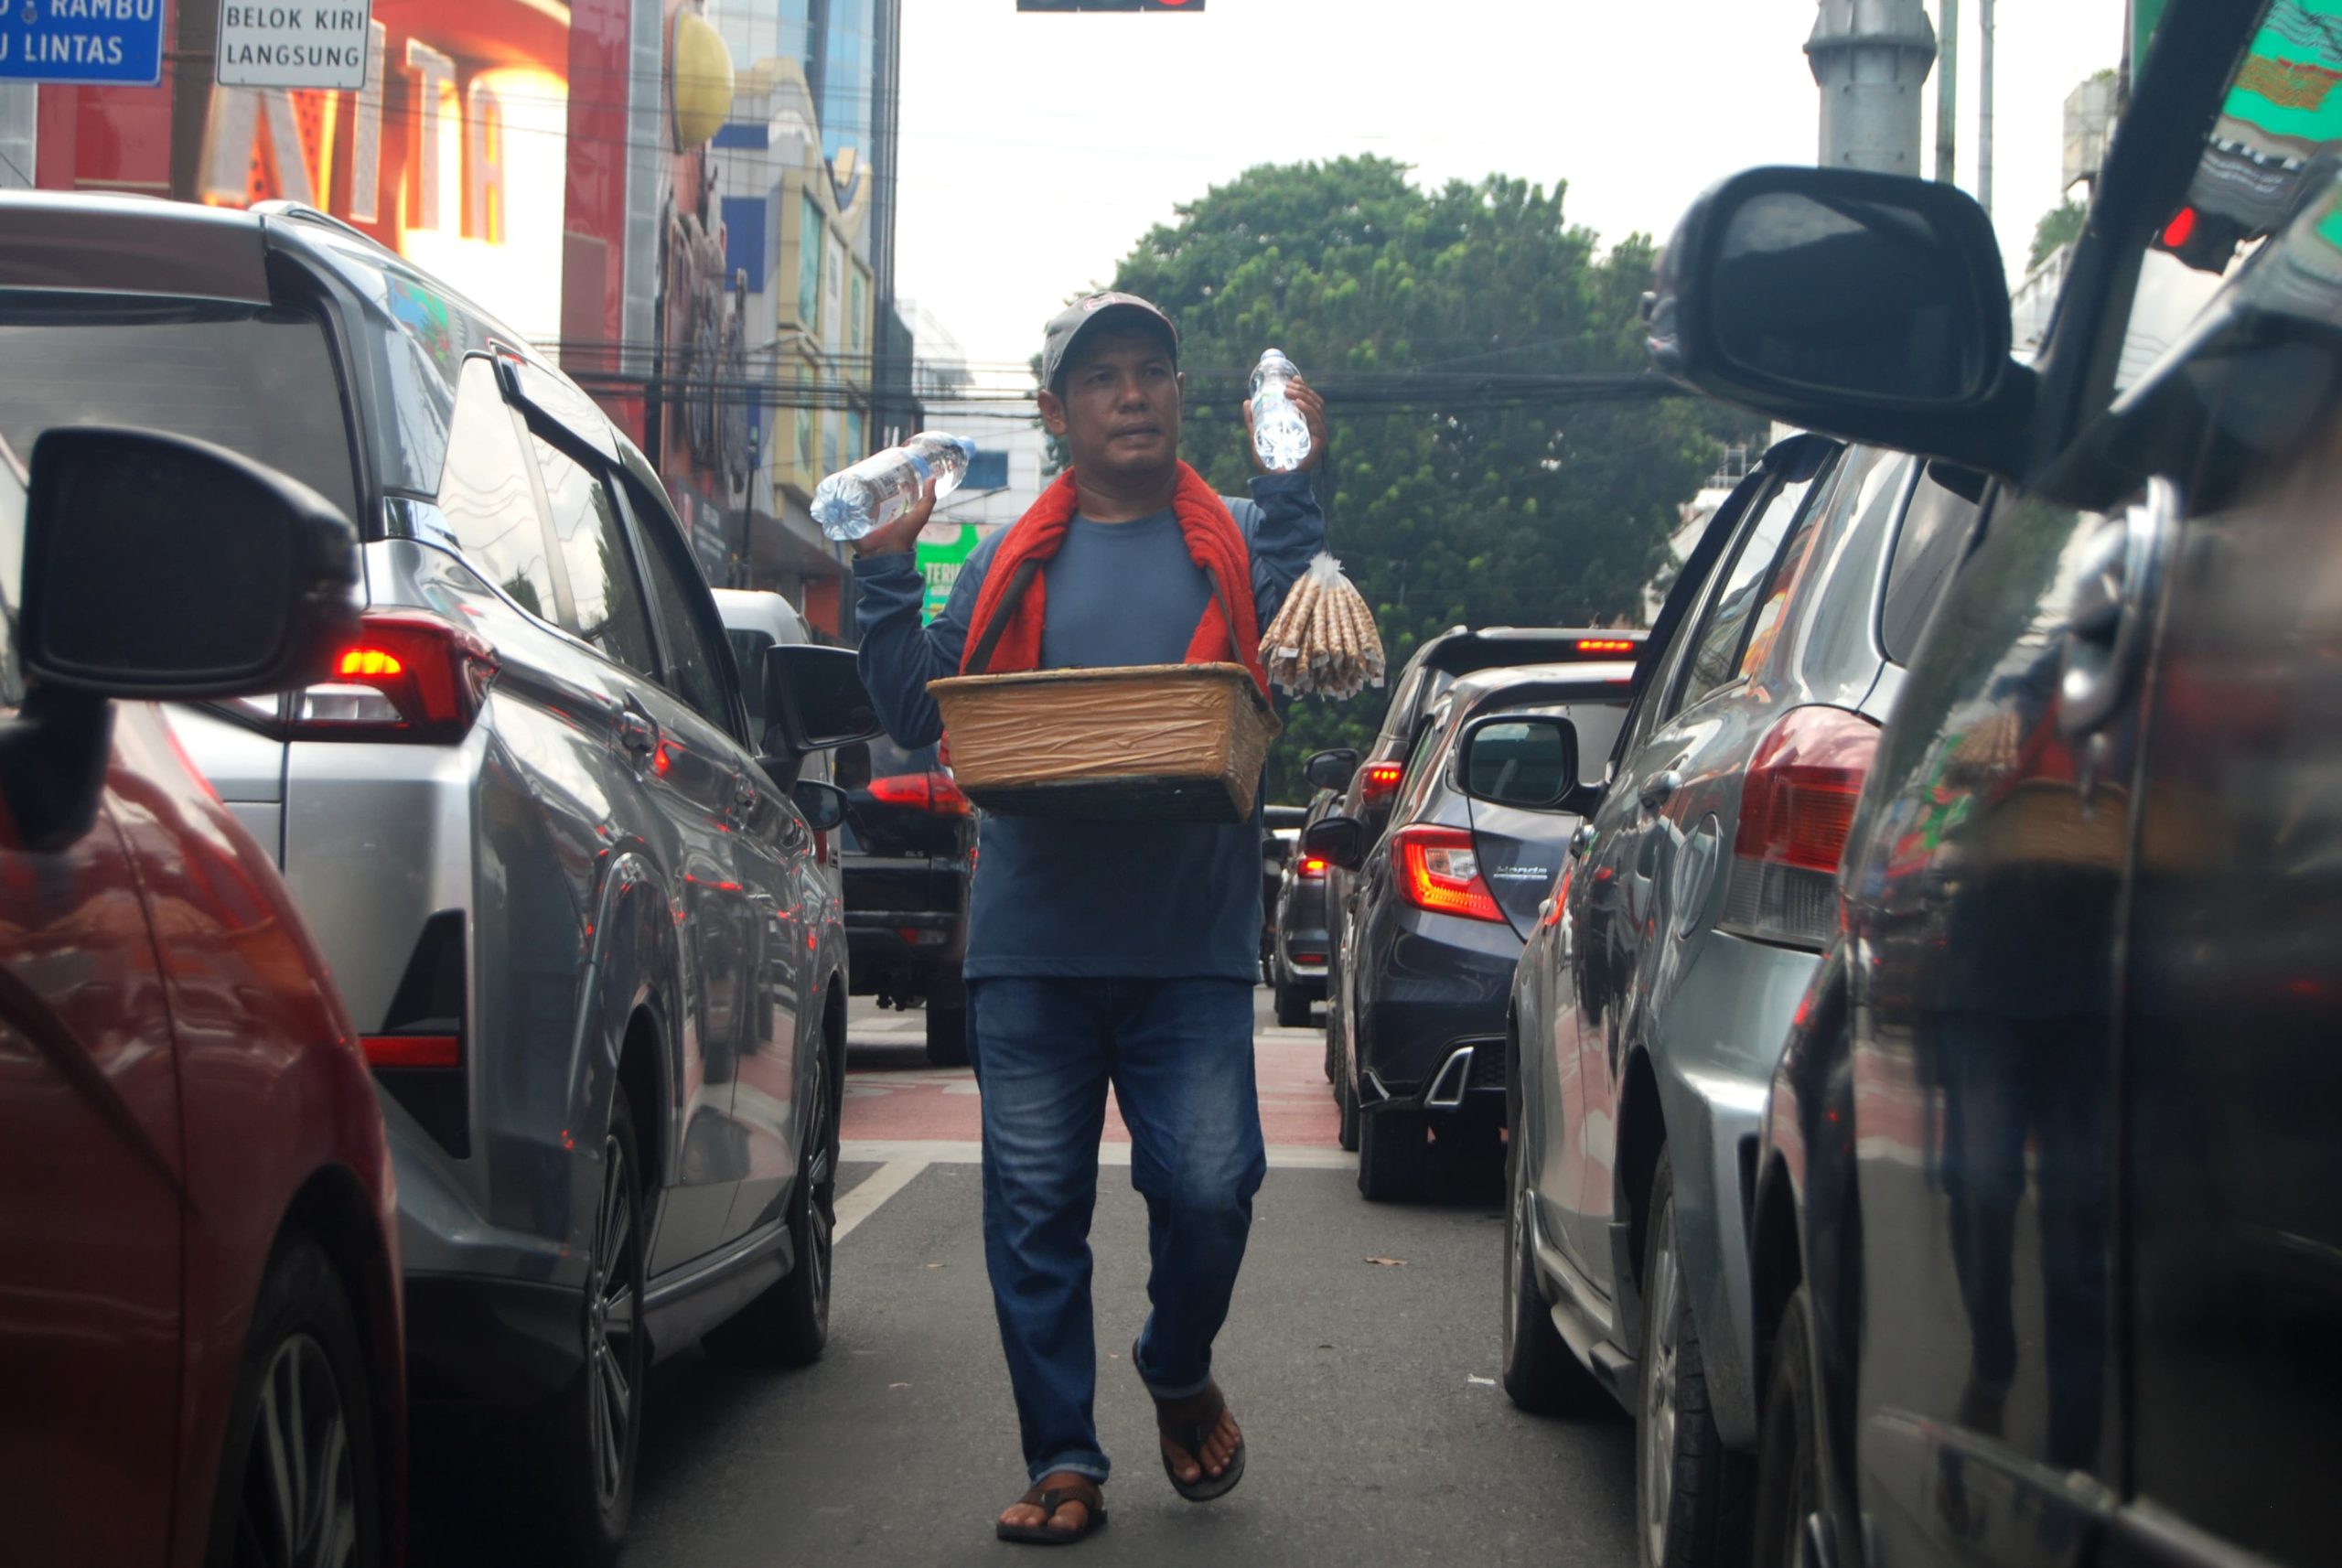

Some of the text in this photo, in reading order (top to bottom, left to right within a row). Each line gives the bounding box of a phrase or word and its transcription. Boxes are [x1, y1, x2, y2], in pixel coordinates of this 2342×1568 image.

[50, 0, 155, 21] RAMBU
[226, 6, 363, 31] BELOK KIRI
[25, 33, 124, 65] LINTAS
[227, 43, 360, 68] LANGSUNG
